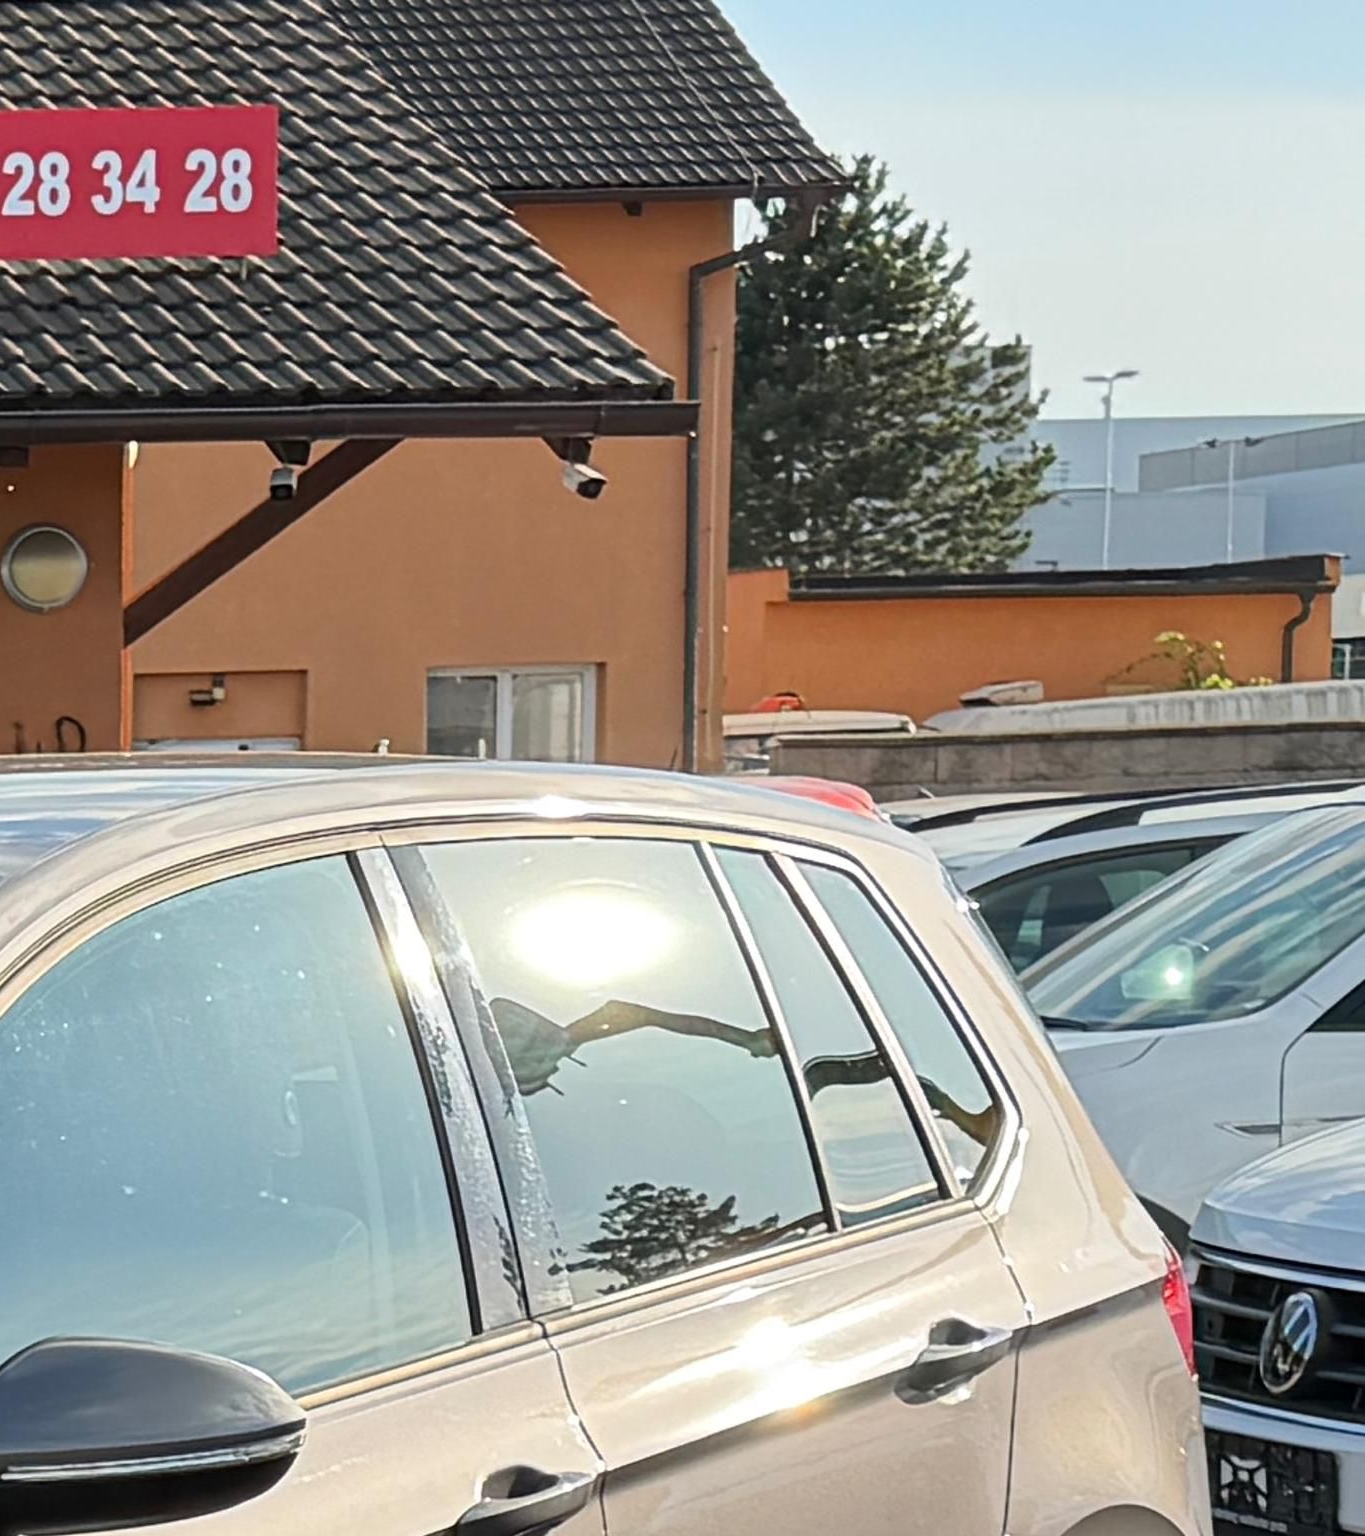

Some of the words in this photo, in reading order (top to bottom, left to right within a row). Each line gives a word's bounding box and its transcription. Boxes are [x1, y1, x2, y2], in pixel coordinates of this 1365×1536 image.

[0, 151, 70, 217] 28
[90, 148, 161, 215] 34
[183, 148, 254, 214] 28
